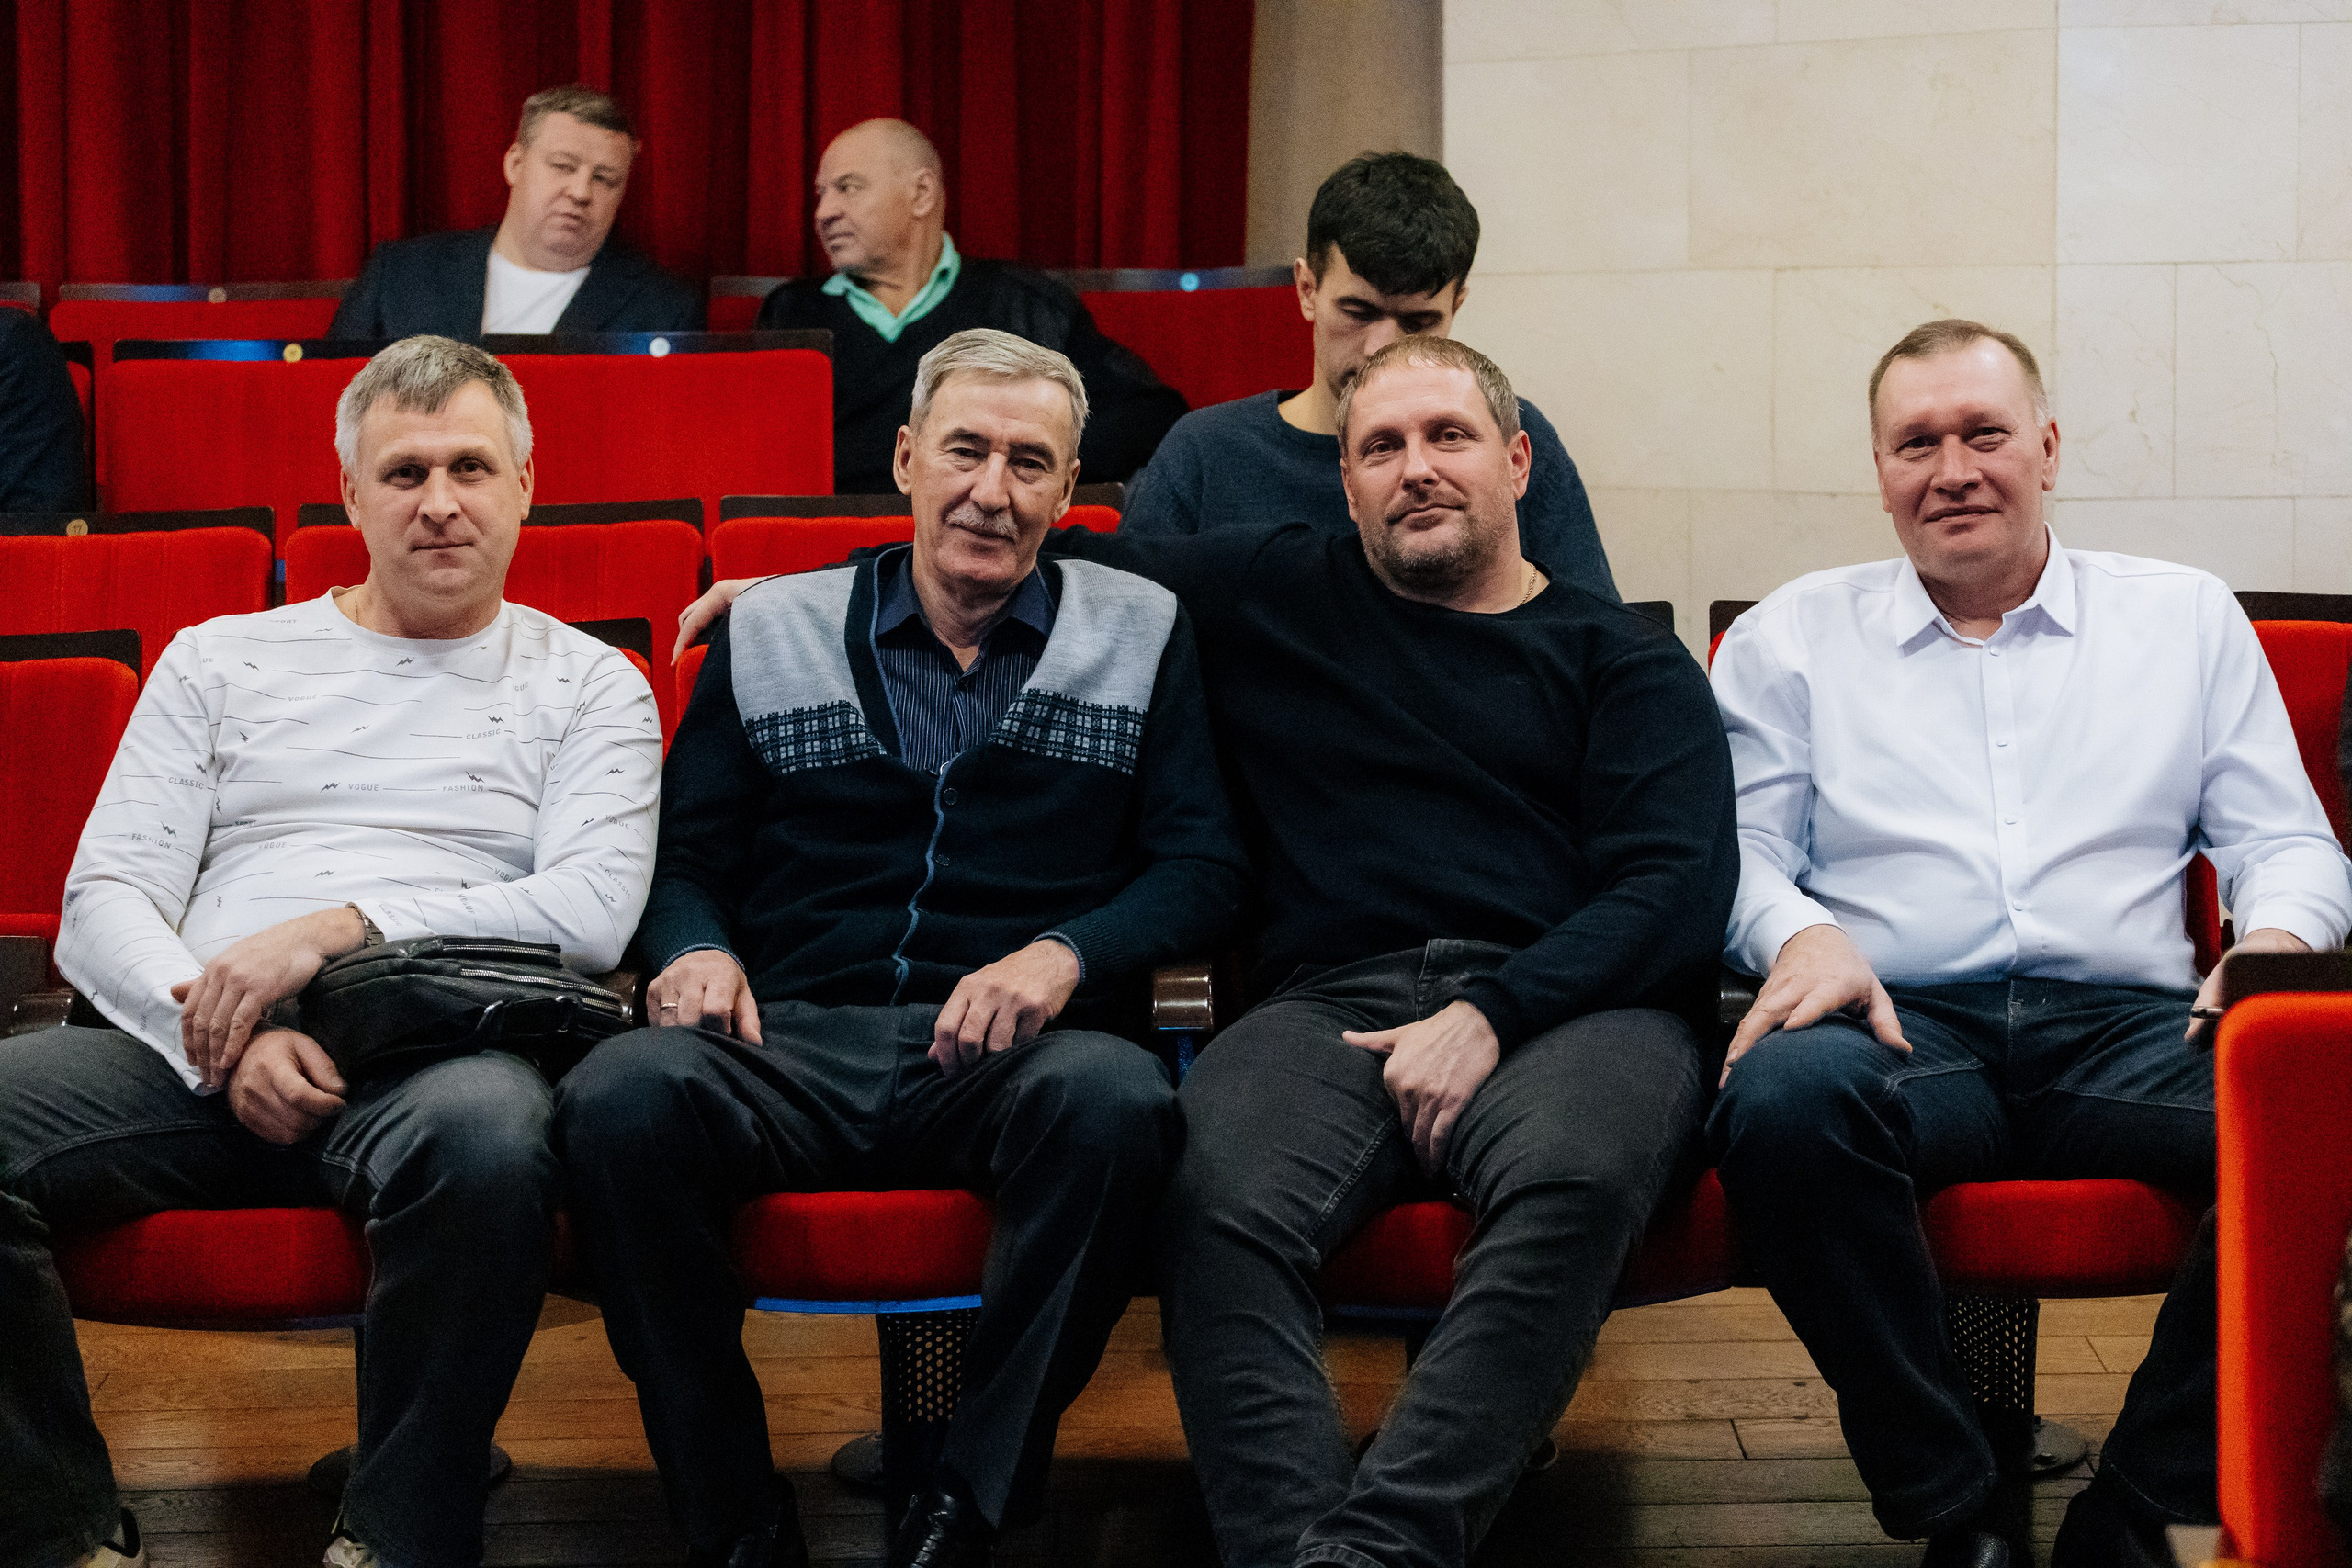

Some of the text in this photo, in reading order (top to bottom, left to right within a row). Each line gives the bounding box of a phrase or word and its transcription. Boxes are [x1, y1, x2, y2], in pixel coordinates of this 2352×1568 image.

[466, 728, 501, 740] CLASSIC
[168, 776, 205, 790] CLASSIC
[348, 784, 379, 792] VOGUE
[131, 833, 172, 850] FASHION
[258, 841, 288, 850] VOGUE
[604, 868, 632, 900] CLASSIC
[458, 893, 476, 915] VOGUE
[379, 903, 403, 927] CLASSIC
